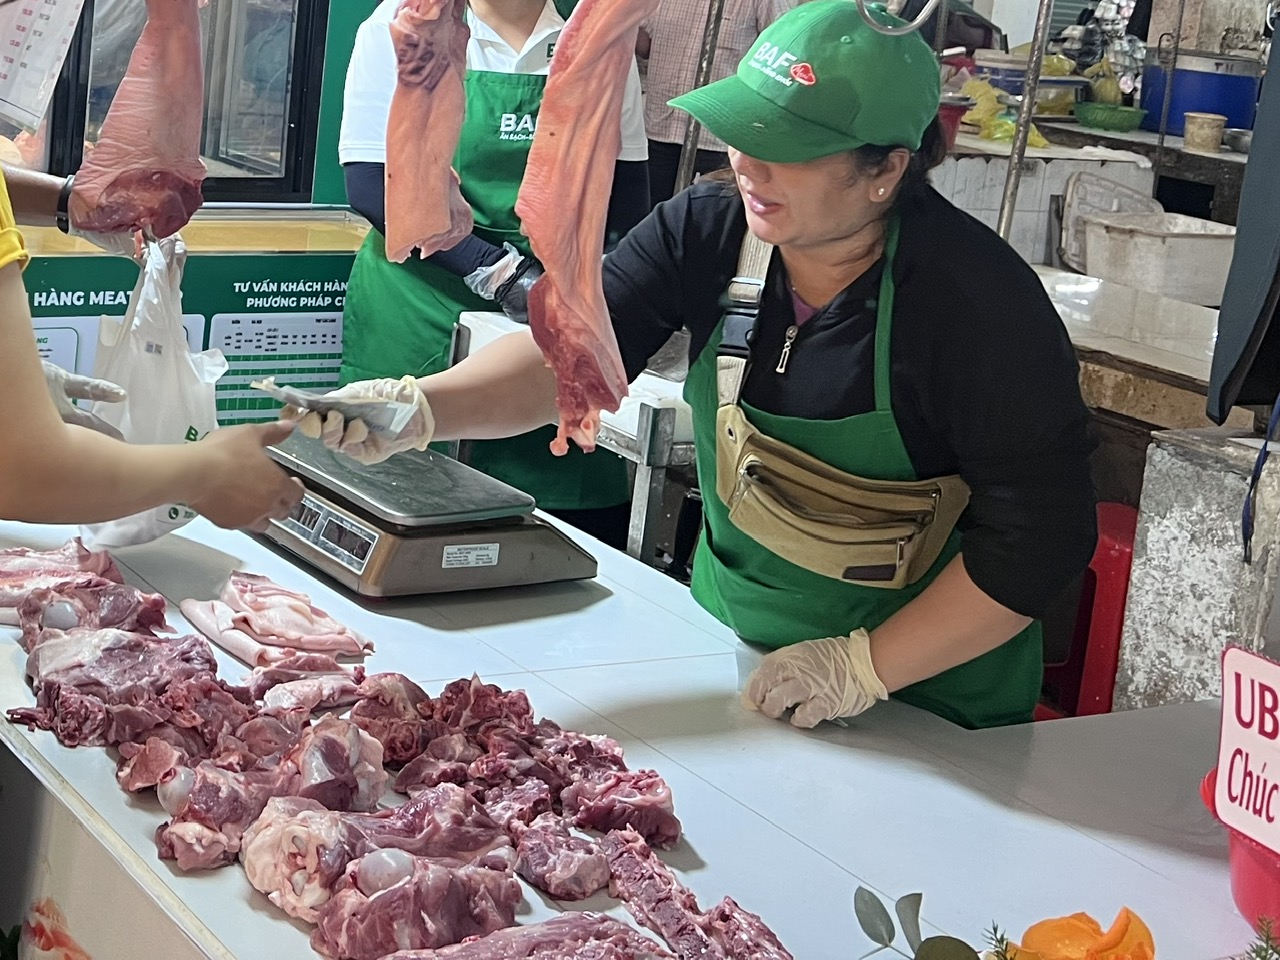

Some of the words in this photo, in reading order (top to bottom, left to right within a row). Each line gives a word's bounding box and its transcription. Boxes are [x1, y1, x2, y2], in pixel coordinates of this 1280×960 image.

[753, 41, 798, 69] BAF
[233, 281, 251, 293] TƯ
[252, 278, 278, 292] VẤN
[280, 279, 321, 292] KHÁCH
[33, 288, 85, 306] HÀNG
[246, 295, 297, 308] PHƯƠNG
[299, 293, 332, 307] PHÁP
[1226, 746, 1279, 823] Chúc
